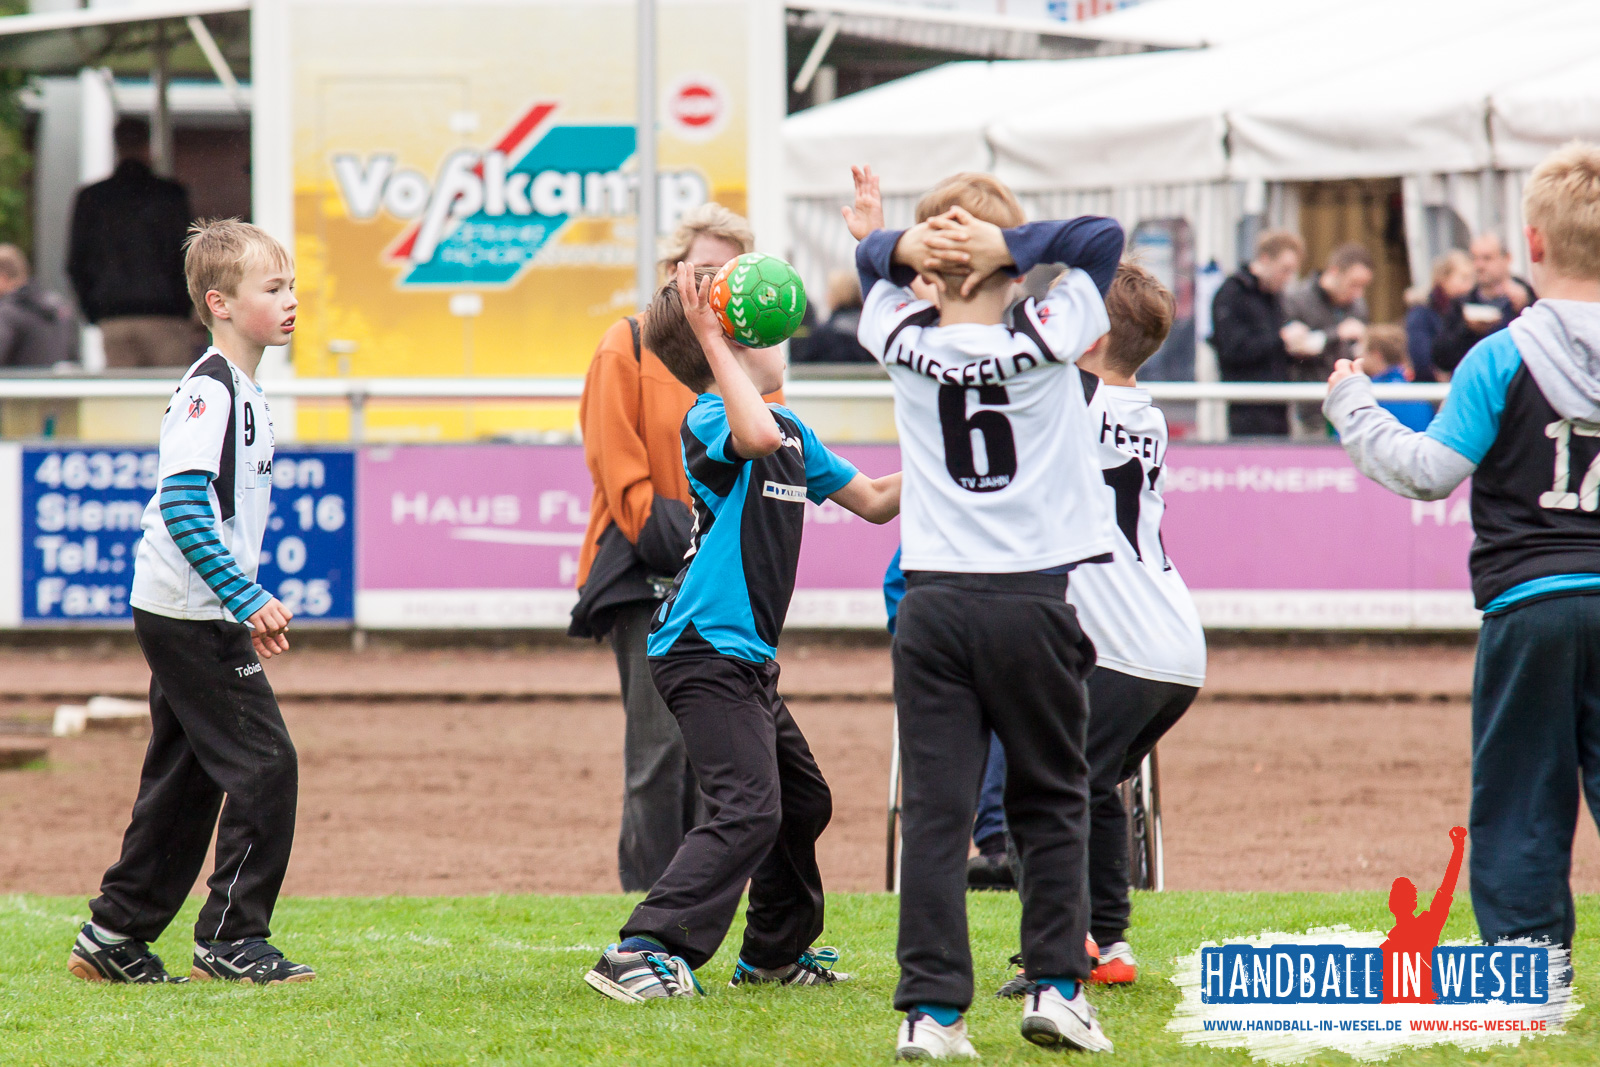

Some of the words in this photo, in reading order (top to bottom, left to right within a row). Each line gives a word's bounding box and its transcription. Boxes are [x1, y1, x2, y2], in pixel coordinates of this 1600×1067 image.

[244, 401, 255, 446] 9
[938, 385, 1018, 492] 6
[959, 477, 976, 489] TV
[977, 474, 1010, 488] JAHN
[293, 494, 345, 531] 16
[391, 492, 520, 525] HAUS
[35, 534, 126, 574] Tel.:
[36, 576, 127, 616] Fax:
